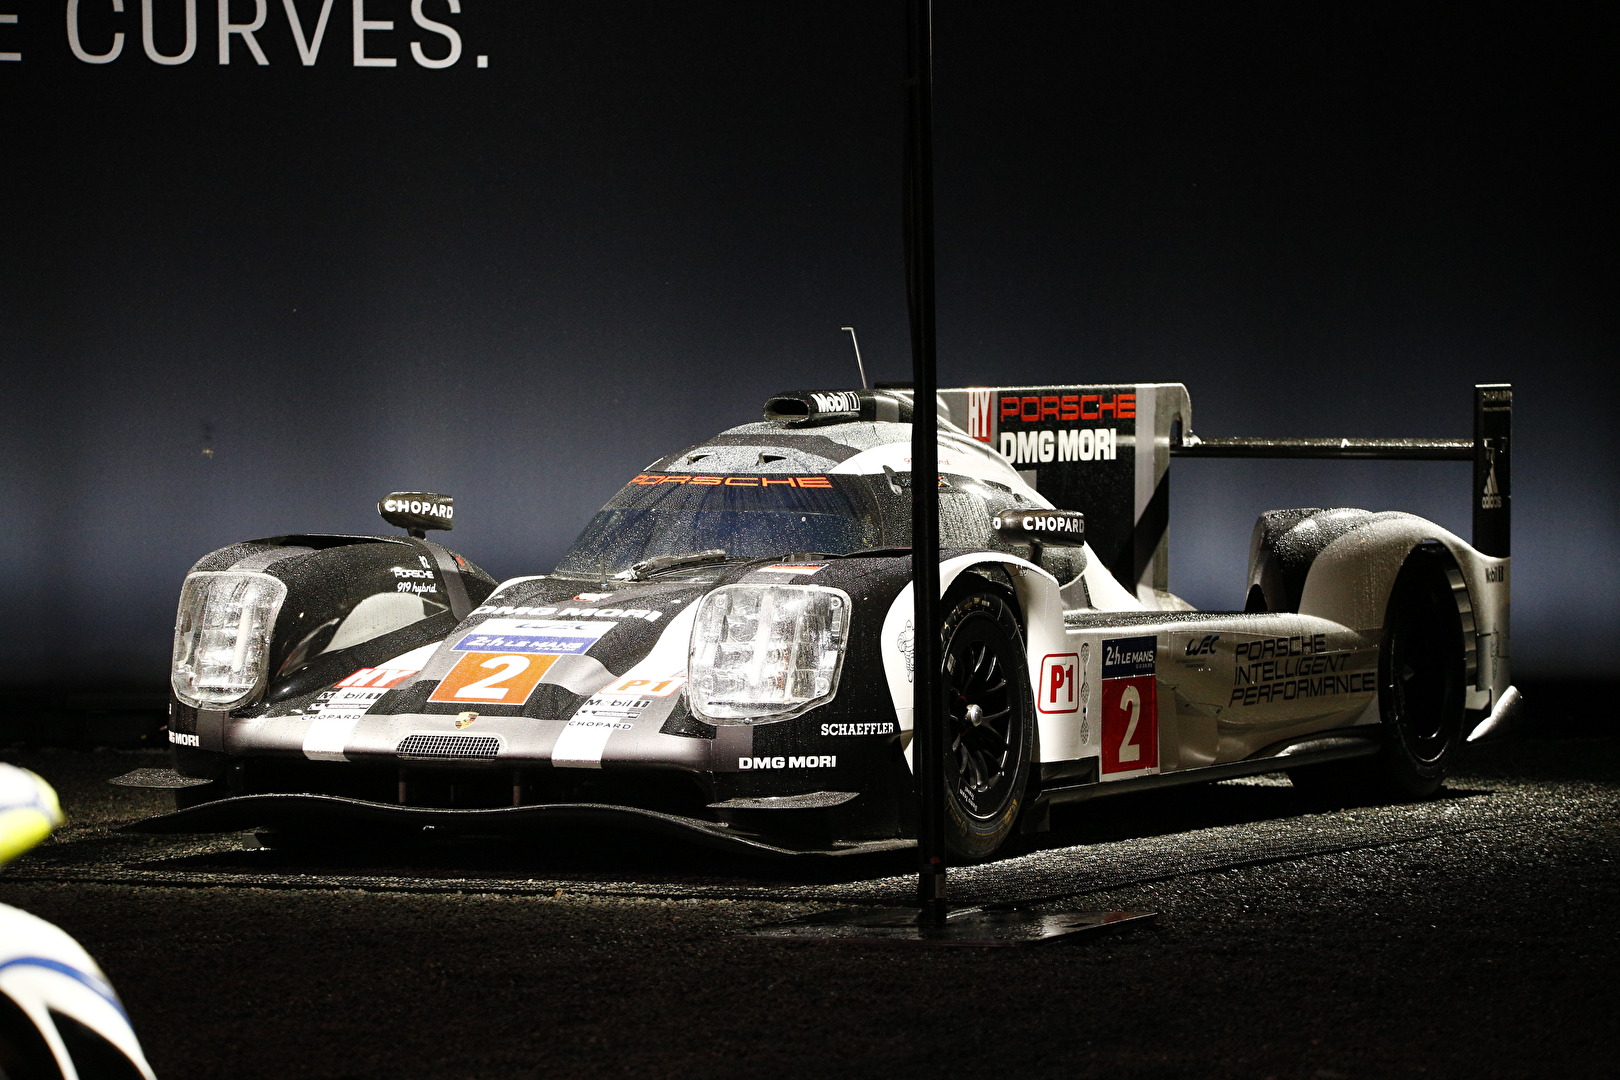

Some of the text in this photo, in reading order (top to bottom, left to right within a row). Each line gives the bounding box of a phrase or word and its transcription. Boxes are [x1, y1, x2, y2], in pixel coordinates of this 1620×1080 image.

[66, 0, 489, 69] CURVES.
[811, 391, 849, 412] Mobil
[1001, 394, 1136, 422] PORSCHE
[968, 390, 992, 437] HY
[1000, 428, 1117, 464] DMG MORI
[627, 474, 834, 489] PORSCHE
[384, 499, 454, 519] CHOPARD
[1022, 516, 1085, 534] CHOPARD
[393, 567, 435, 579] PORSCHE
[397, 581, 438, 598] 919 hybrid
[468, 605, 663, 622] DMG MORI
[1105, 645, 1155, 666] 24h LE MANS
[1185, 634, 1220, 656] WEC
[1236, 633, 1326, 663] PORSCHE
[337, 667, 415, 687] HY
[454, 655, 531, 700] 2
[1234, 653, 1351, 686] INTELLIGENT
[616, 680, 674, 692] P1
[1050, 665, 1074, 703] P1
[1229, 672, 1375, 707] PERFORMANCE
[568, 721, 633, 730] CHOPARD
[820, 722, 894, 736] SCHAEFFLER
[1118, 685, 1141, 763] 2
[175, 732, 200, 747] MORI
[738, 755, 837, 769] DMG MORI
